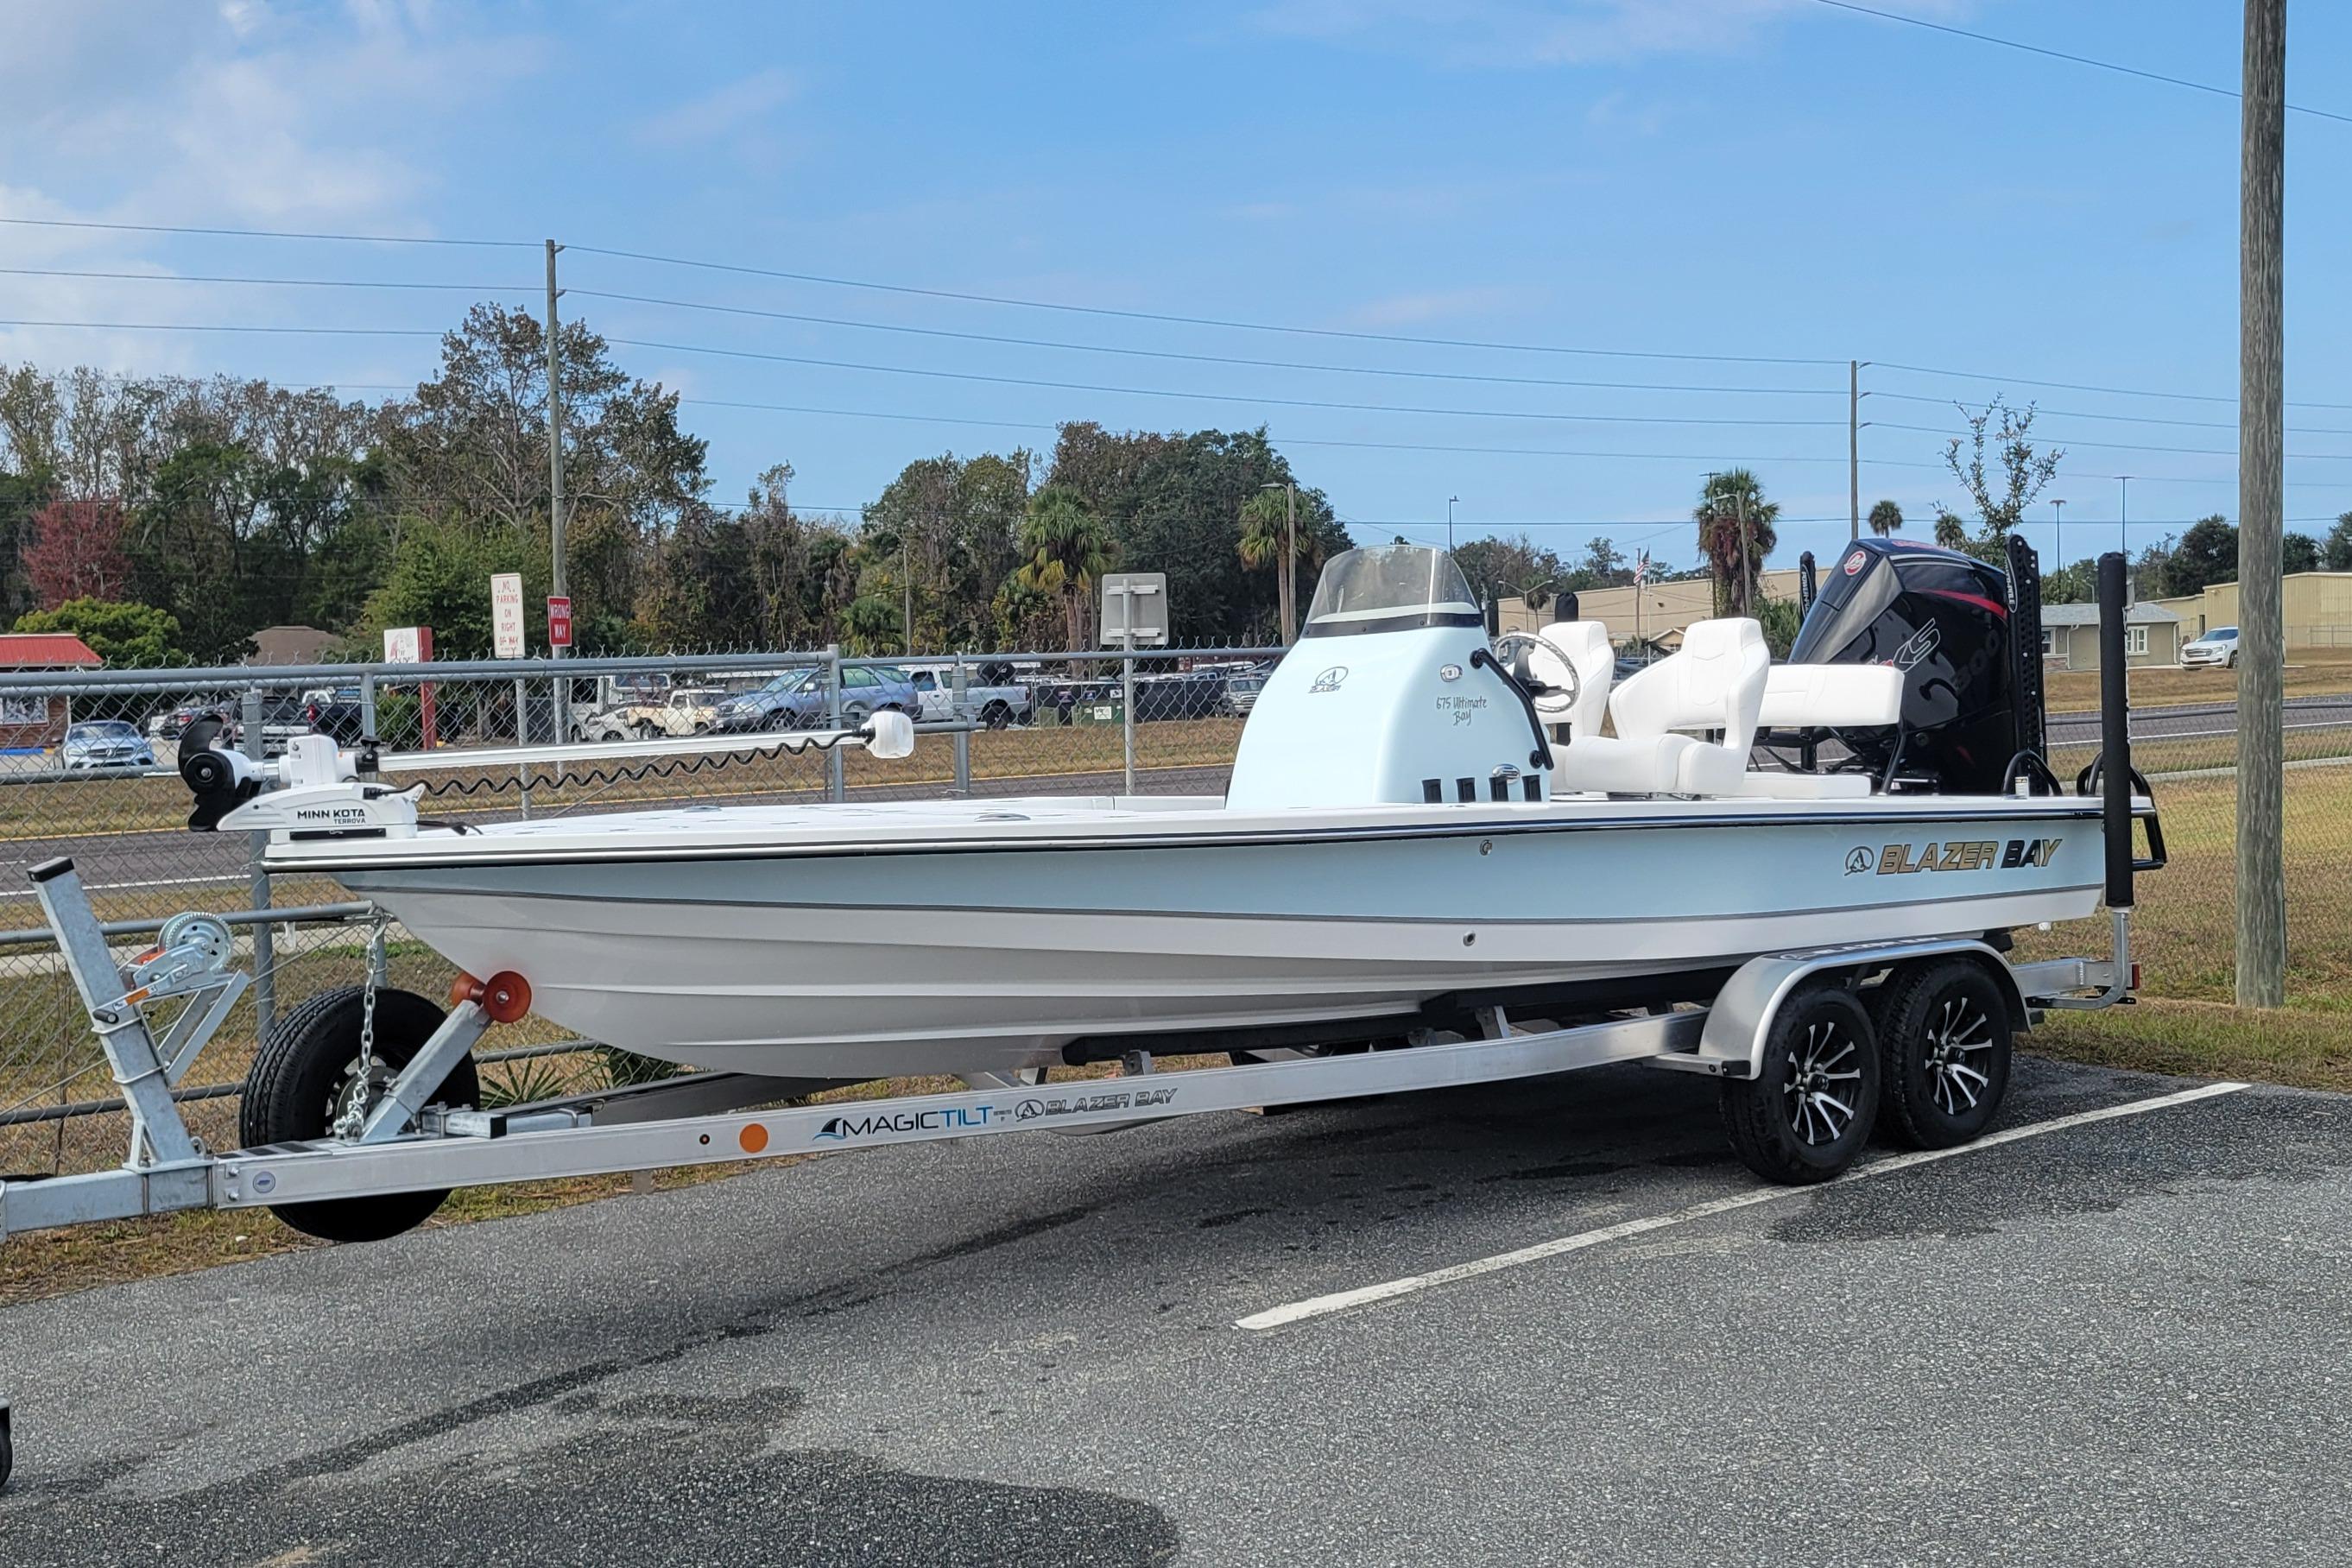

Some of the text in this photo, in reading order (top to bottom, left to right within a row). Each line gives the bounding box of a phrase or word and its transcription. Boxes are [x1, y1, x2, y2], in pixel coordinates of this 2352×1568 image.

[503, 580, 510, 591] NO
[496, 594, 519, 605] PARKING
[504, 609, 512, 618] ON
[550, 604, 570, 620] WRONG
[501, 622, 515, 632] RIGHT
[554, 623, 566, 639] WAY
[509, 635, 519, 647] WAY
[1437, 695, 1487, 710] 675 Ultimate
[1453, 709, 1471, 726] Bay
[297, 808, 366, 819] MINN KOTA
[334, 817, 367, 825] TERROVA
[1876, 838, 2063, 876] BLAZER BAY
[842, 1106, 994, 1136] MAGICTILT
[1046, 1092, 1130, 1116] BLAZER
[1135, 1087, 1179, 1107] BAY
